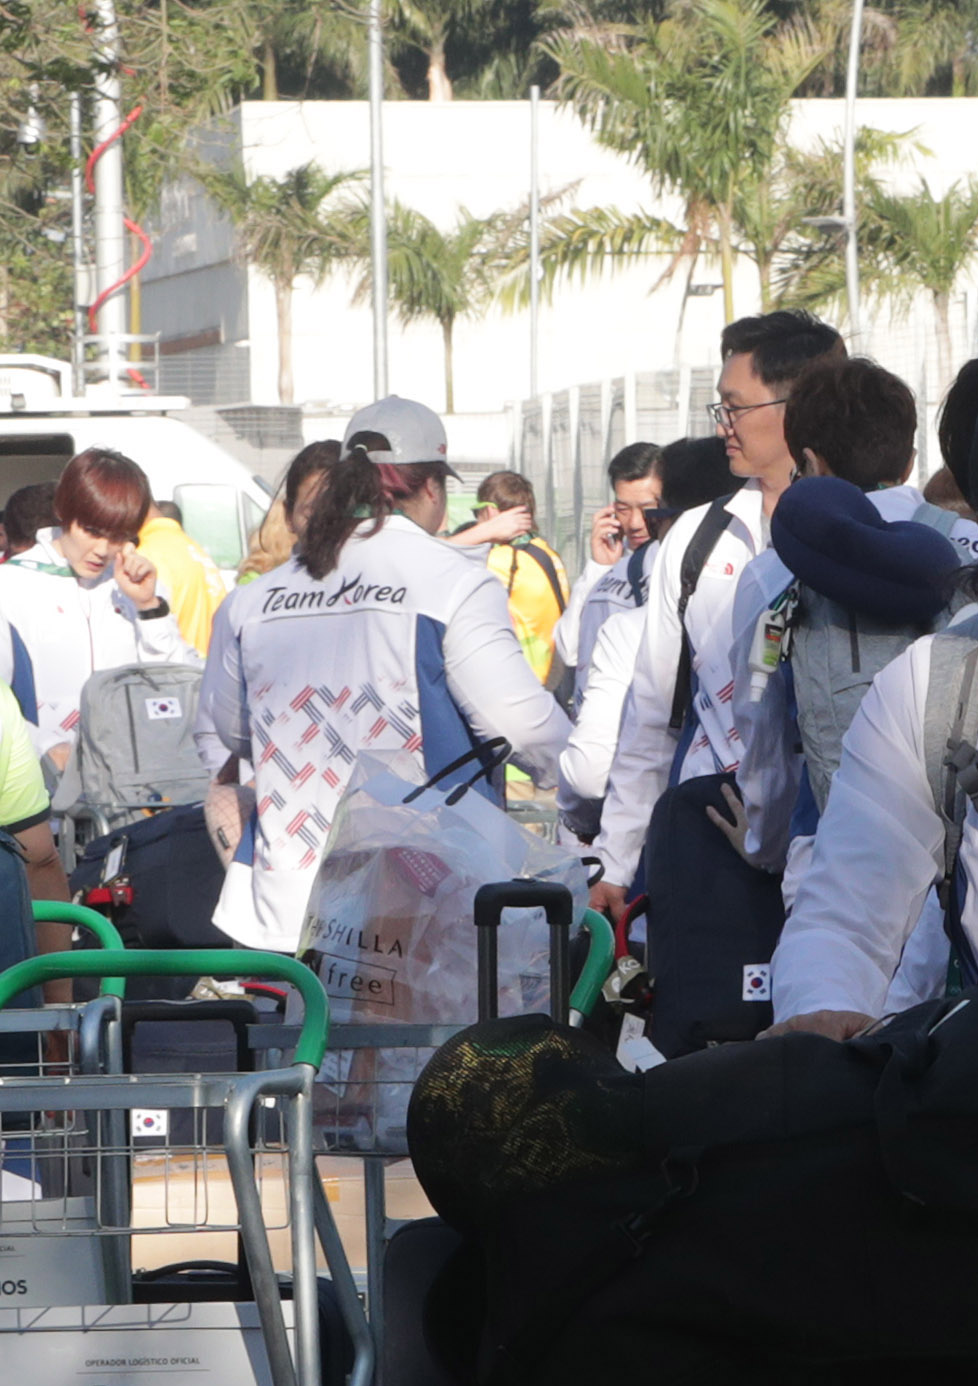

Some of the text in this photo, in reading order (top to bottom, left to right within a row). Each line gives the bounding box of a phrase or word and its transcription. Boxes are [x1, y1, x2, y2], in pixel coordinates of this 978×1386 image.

[262, 572, 408, 614] Team Korea
[323, 918, 404, 958] SHILLA
[327, 962, 383, 995] free
[85, 1357, 127, 1368] OPERADOR
[170, 1356, 200, 1366] OFICIAL
